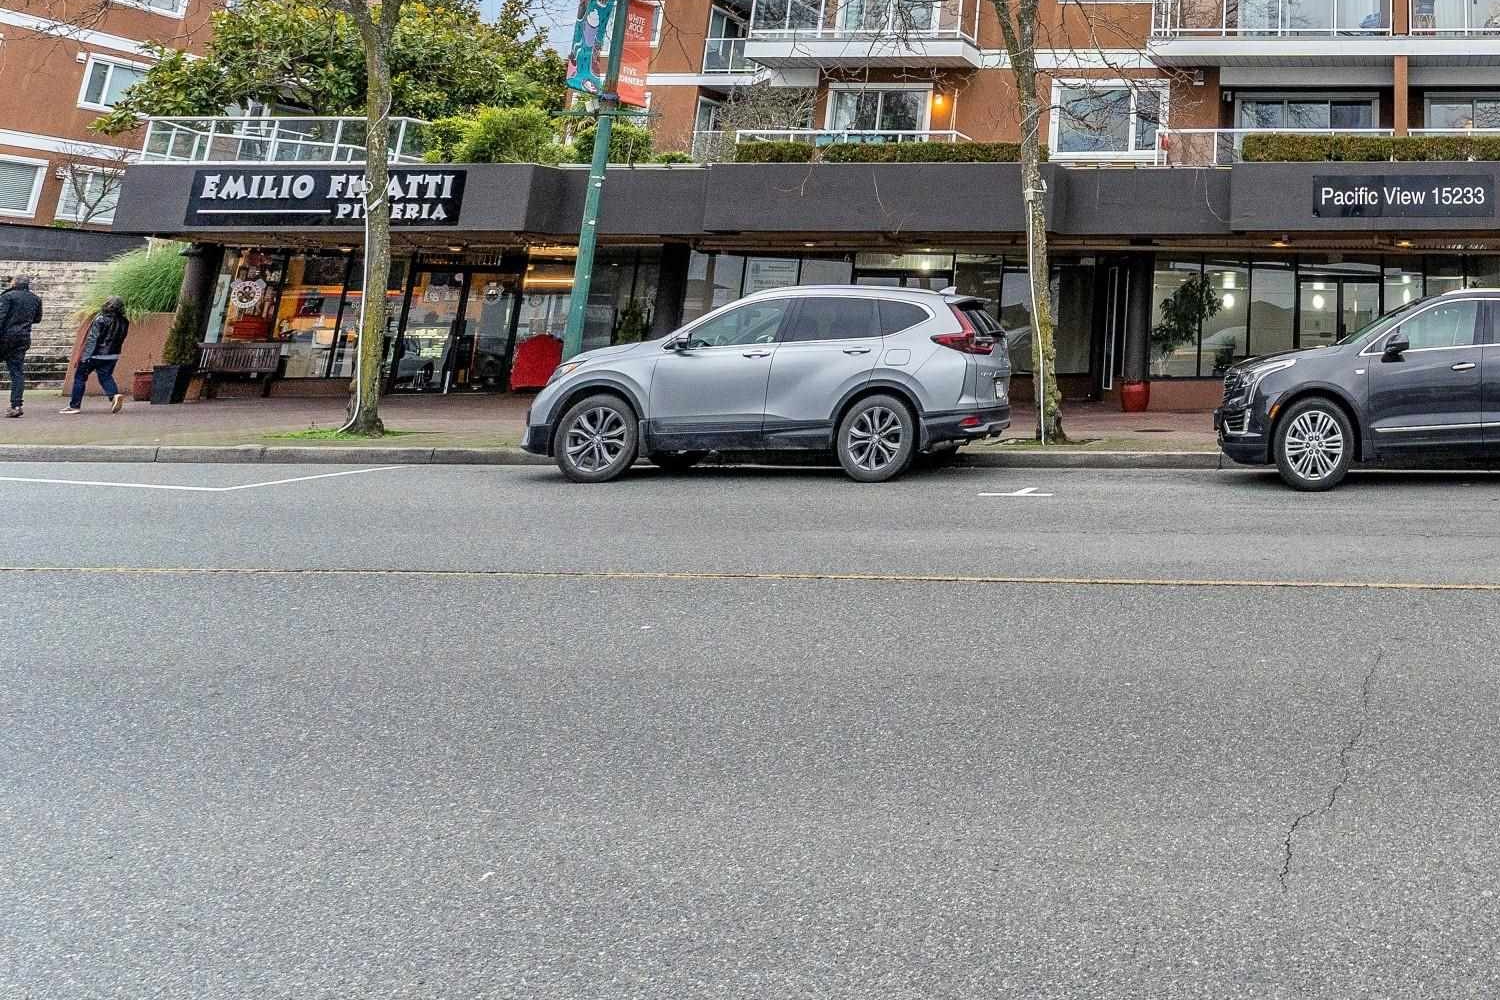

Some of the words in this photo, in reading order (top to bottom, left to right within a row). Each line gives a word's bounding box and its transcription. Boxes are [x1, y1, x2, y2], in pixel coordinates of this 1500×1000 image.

[628, 13, 646, 26] WHITE
[628, 23, 645, 34] ROCK
[200, 174, 316, 200] EMILIO
[326, 173, 456, 200] FIATTI
[1321, 187, 1379, 206] Pacific
[1384, 187, 1426, 206] View
[1431, 187, 1485, 206] 15233
[335, 203, 449, 221] PIERIA
